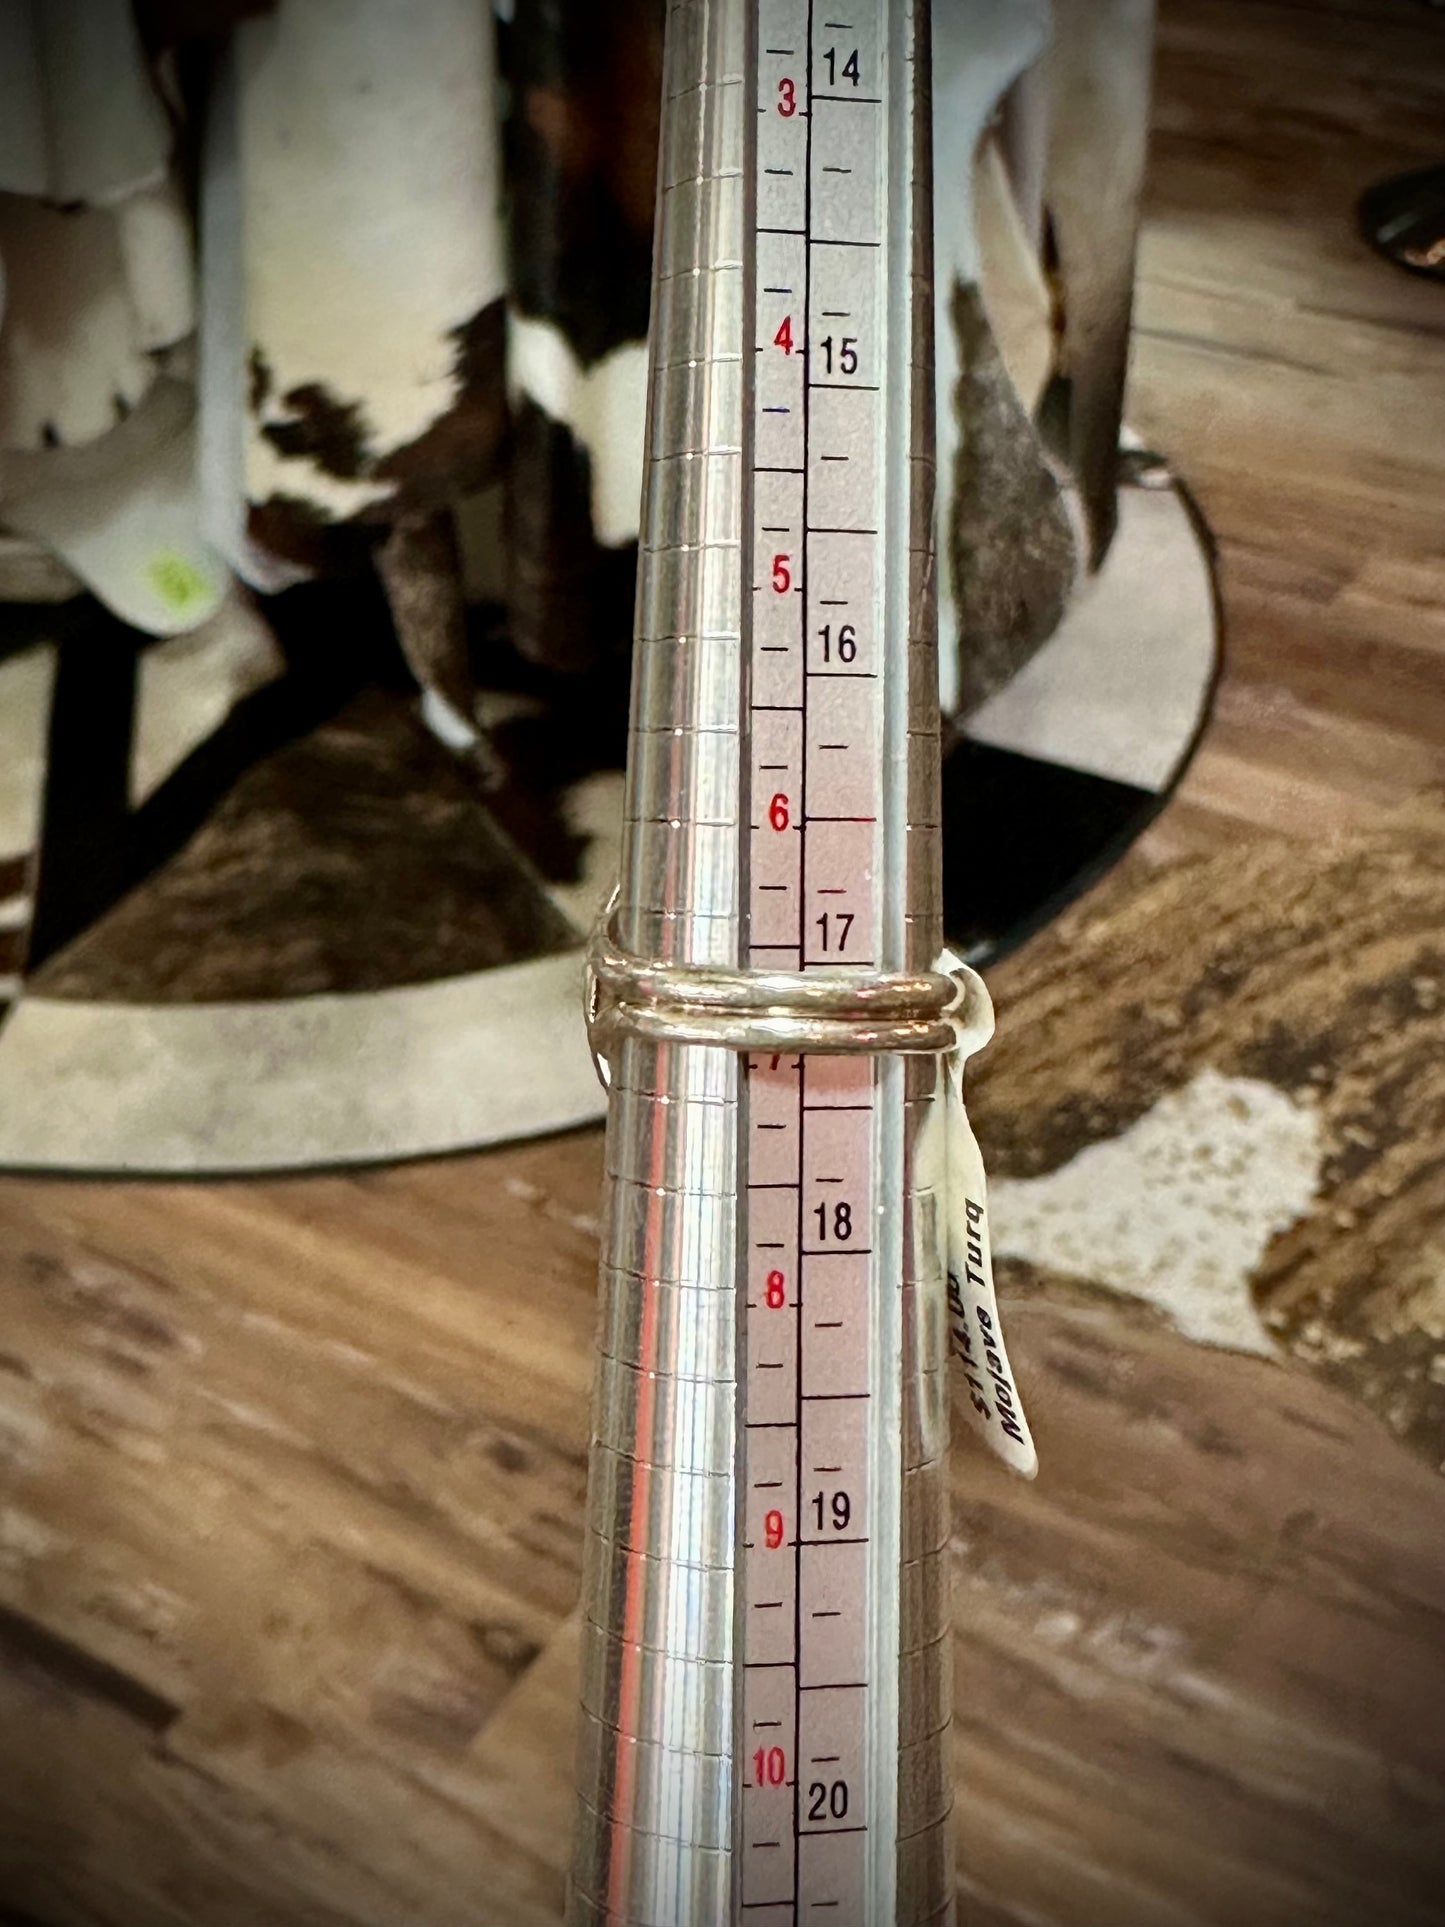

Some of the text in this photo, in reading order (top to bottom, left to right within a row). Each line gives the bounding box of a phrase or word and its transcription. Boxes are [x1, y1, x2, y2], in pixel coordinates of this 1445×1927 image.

[823, 47, 860, 87] 14
[777, 78, 796, 117] 3
[774, 315, 793, 355] 4
[820, 336, 858, 374] 15
[772, 554, 790, 593] 5
[818, 624, 857, 663] 16
[768, 793, 790, 832] 6
[816, 912, 855, 952] 17
[814, 1201, 852, 1241] 18
[766, 1270, 785, 1309] 8
[964, 1198, 1025, 1446] Mojave Turq
[764, 1510, 783, 1549] 9
[812, 1491, 851, 1531] 19
[753, 1746, 785, 1788] 10
[808, 1780, 848, 1821] 20
